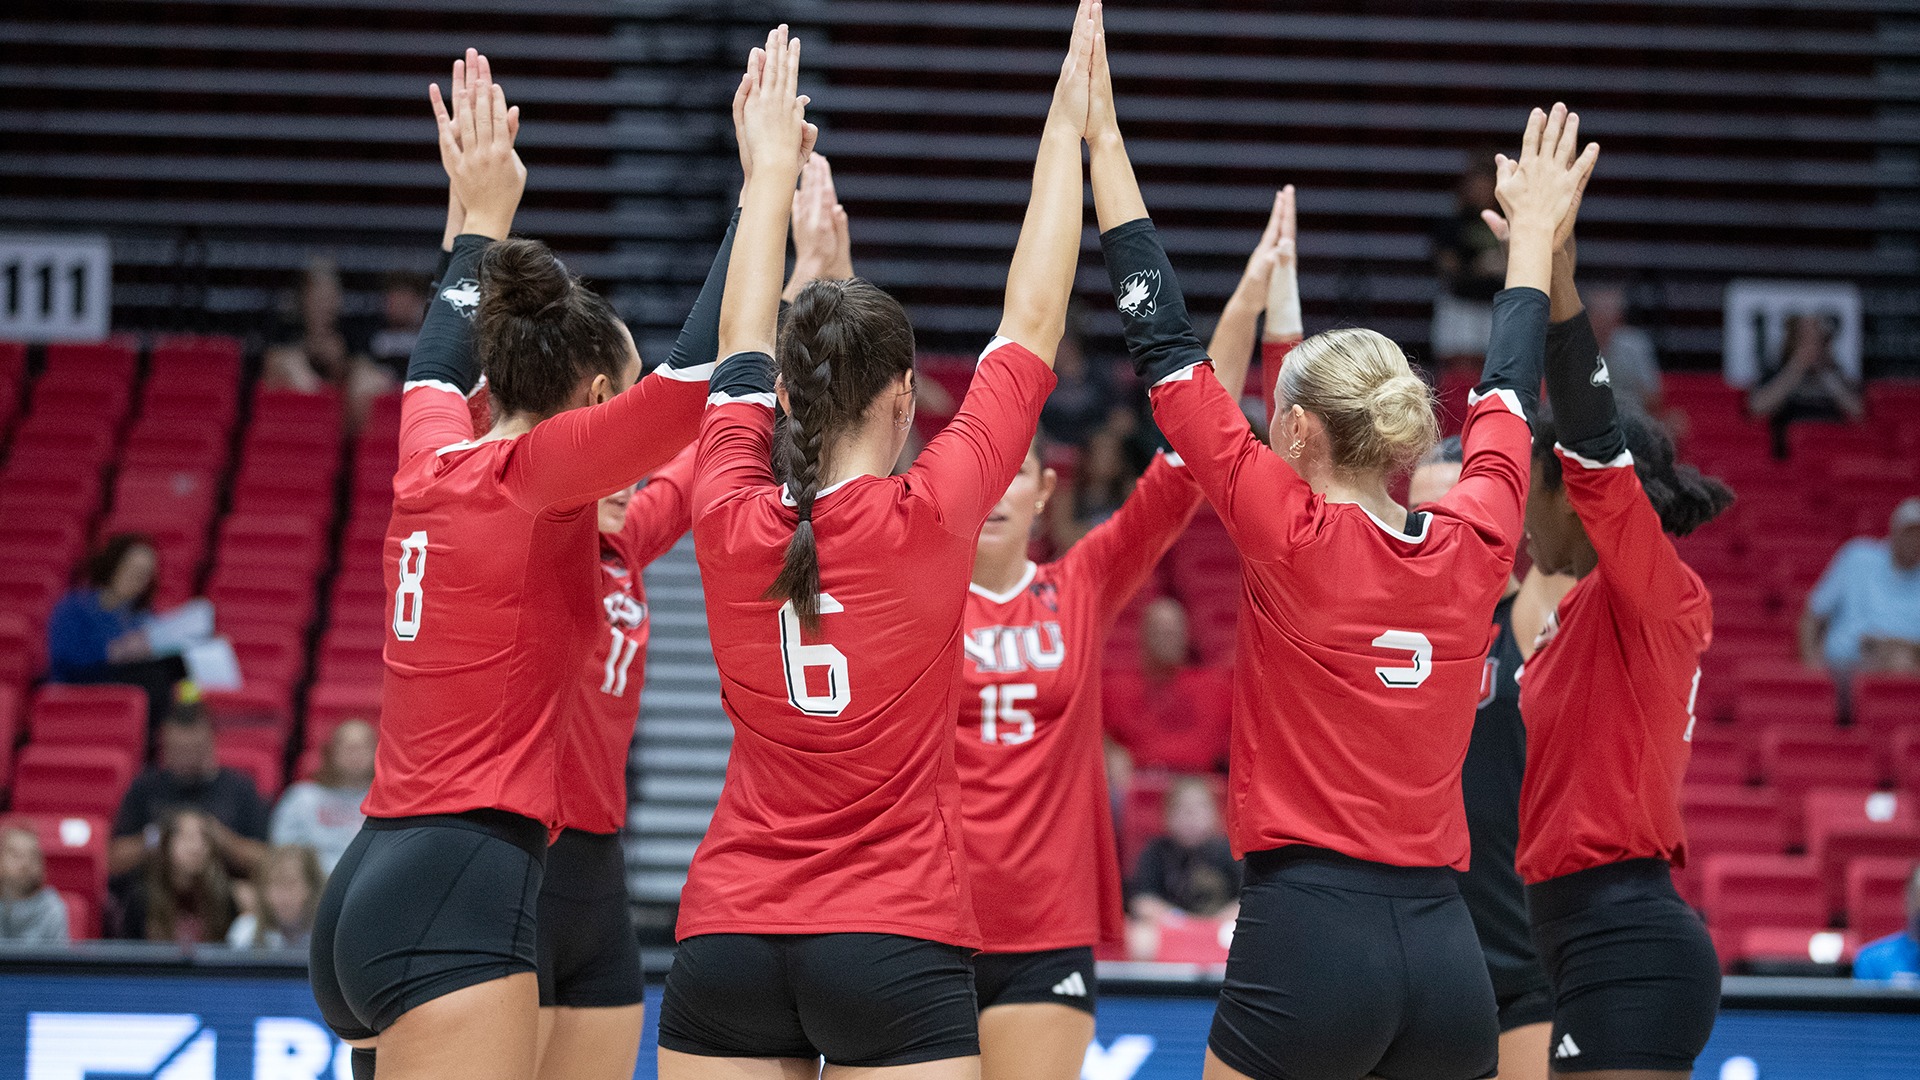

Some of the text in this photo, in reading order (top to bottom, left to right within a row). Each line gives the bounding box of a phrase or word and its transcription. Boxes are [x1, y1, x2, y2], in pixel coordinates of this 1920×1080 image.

[2, 258, 88, 318] 111
[393, 531, 428, 641] 8
[600, 626, 639, 698] 11
[778, 592, 851, 717] 6
[1371, 629, 1433, 689] 3
[978, 683, 1038, 746] 15
